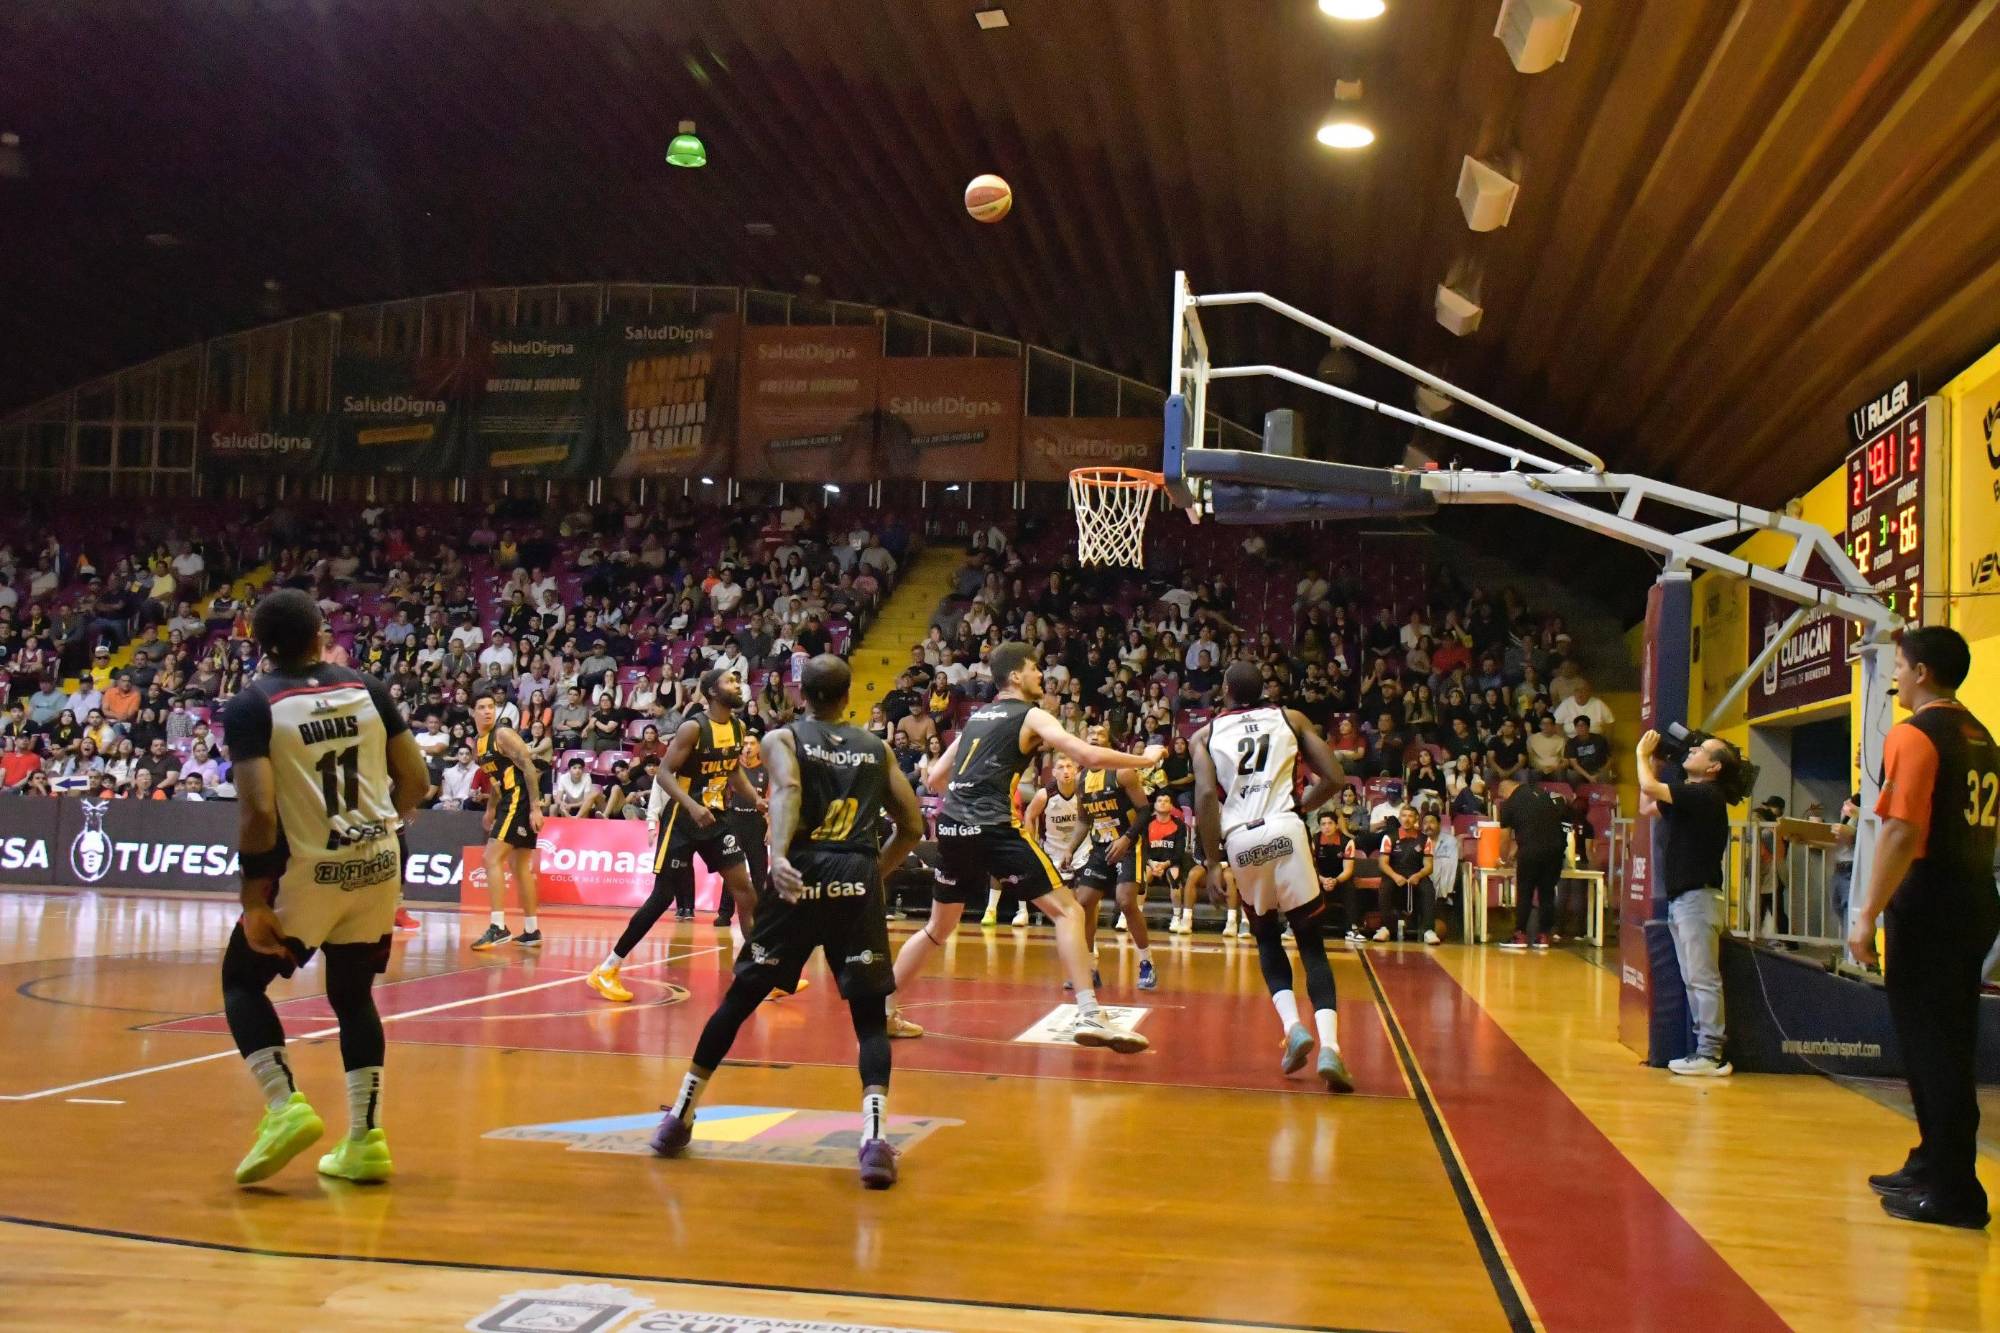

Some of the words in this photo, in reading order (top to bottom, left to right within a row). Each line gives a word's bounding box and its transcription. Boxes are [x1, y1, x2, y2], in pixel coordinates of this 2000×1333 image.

[625, 325, 713, 344] SaludDigna
[491, 340, 574, 357] SaludDigna
[757, 343, 857, 363] SaludDigna
[343, 396, 447, 417] SaludDigna
[889, 396, 1001, 420] SaludDigna
[1867, 380, 1908, 432] RULER
[210, 431, 313, 453] SaludDigna
[1034, 439, 1148, 461] SaludDigna
[1909, 437, 1921, 472] 2
[1899, 505, 1917, 555] 66
[1780, 622, 1831, 668] CULIACÁN
[298, 714, 359, 746] BURNS
[1245, 723, 1260, 734] LEE
[803, 743, 876, 767] SaludDigna
[1237, 733, 1271, 776] 21
[315, 744, 360, 838] 11
[1963, 769, 1999, 827] 32
[938, 823, 957, 837] Soni
[958, 823, 982, 837] Gas
[317, 863, 341, 882] El
[826, 880, 867, 898] Gas
